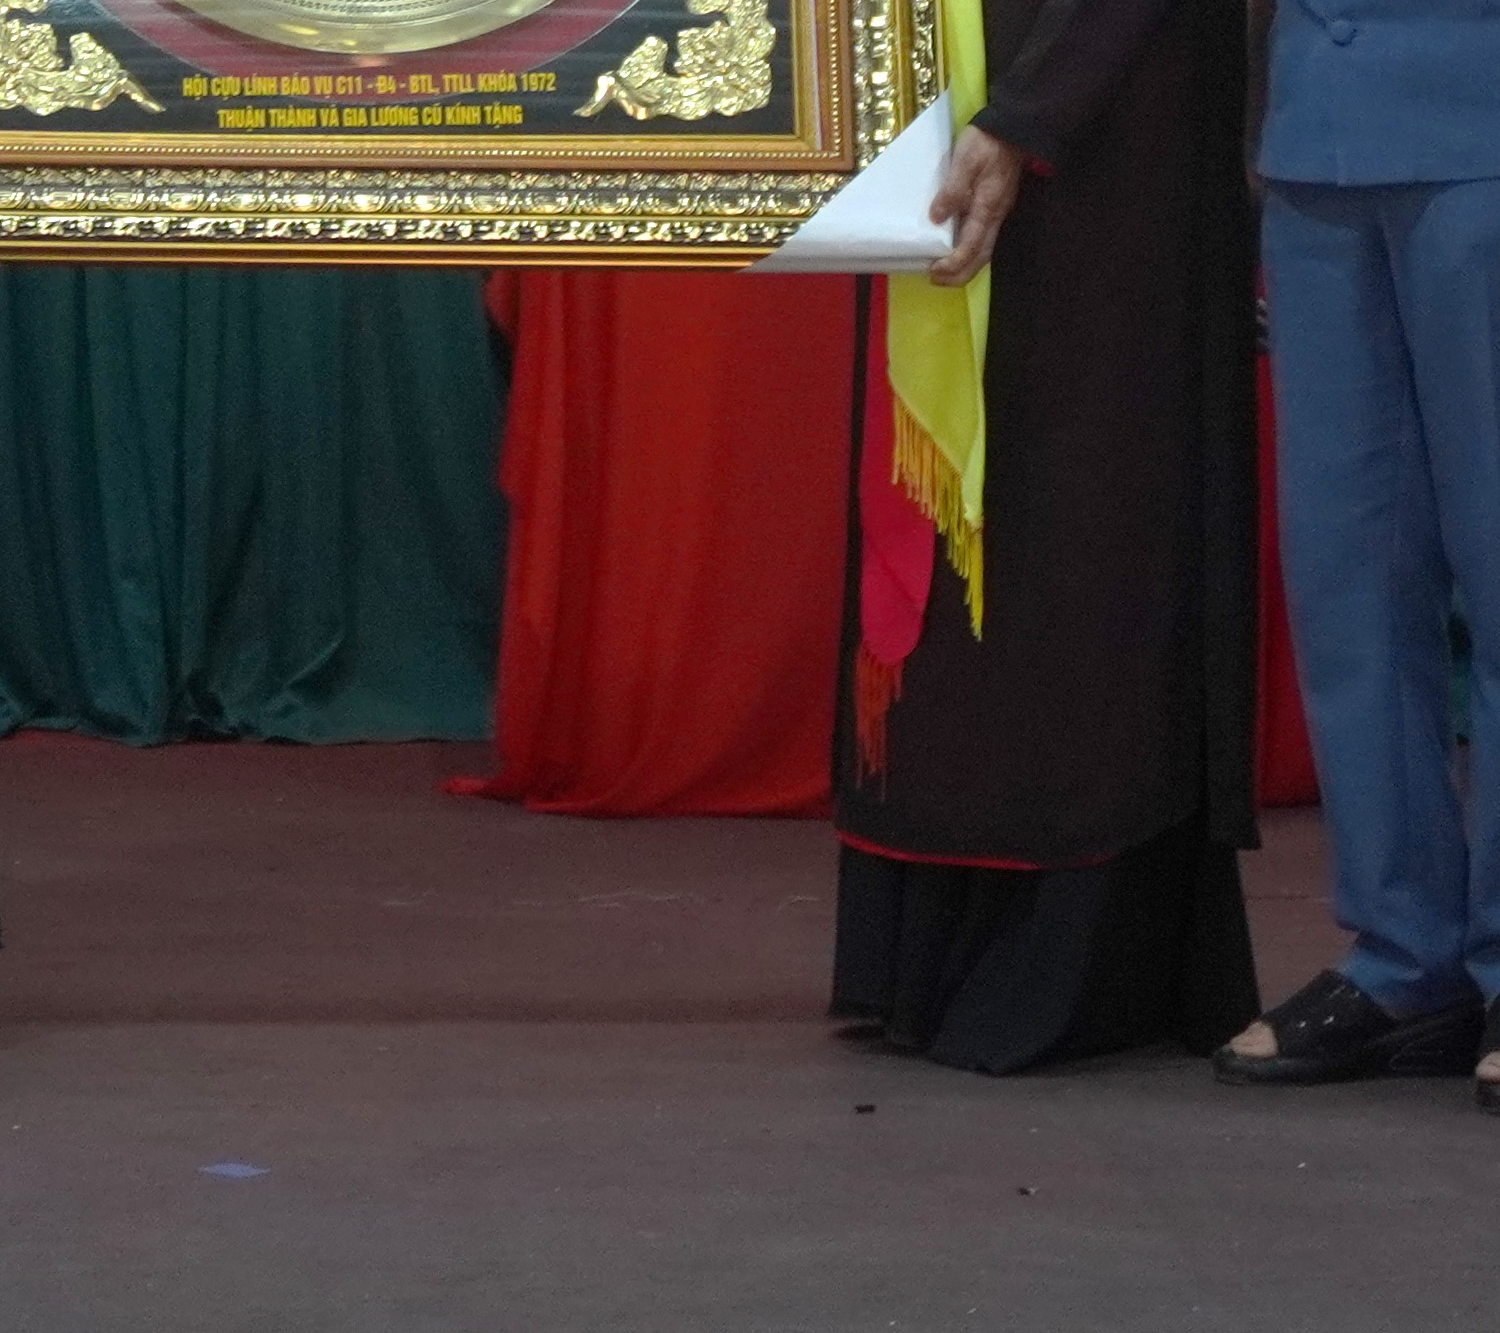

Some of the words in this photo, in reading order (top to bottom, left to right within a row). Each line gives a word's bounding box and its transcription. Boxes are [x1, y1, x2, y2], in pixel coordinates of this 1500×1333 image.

[182, 73, 209, 101] HỘI
[210, 74, 242, 101] CỰU
[243, 72, 278, 96] LÍNH
[313, 75, 333, 99] VỤ
[335, 75, 363, 96] C11
[442, 73, 475, 94] TTLL
[477, 69, 518, 94] KHÓA
[520, 72, 557, 93] 1972
[217, 105, 266, 132] THUẬN
[342, 107, 369, 127] GIA
[445, 101, 482, 126] KÍNH
[484, 101, 524, 129] TẶNG
